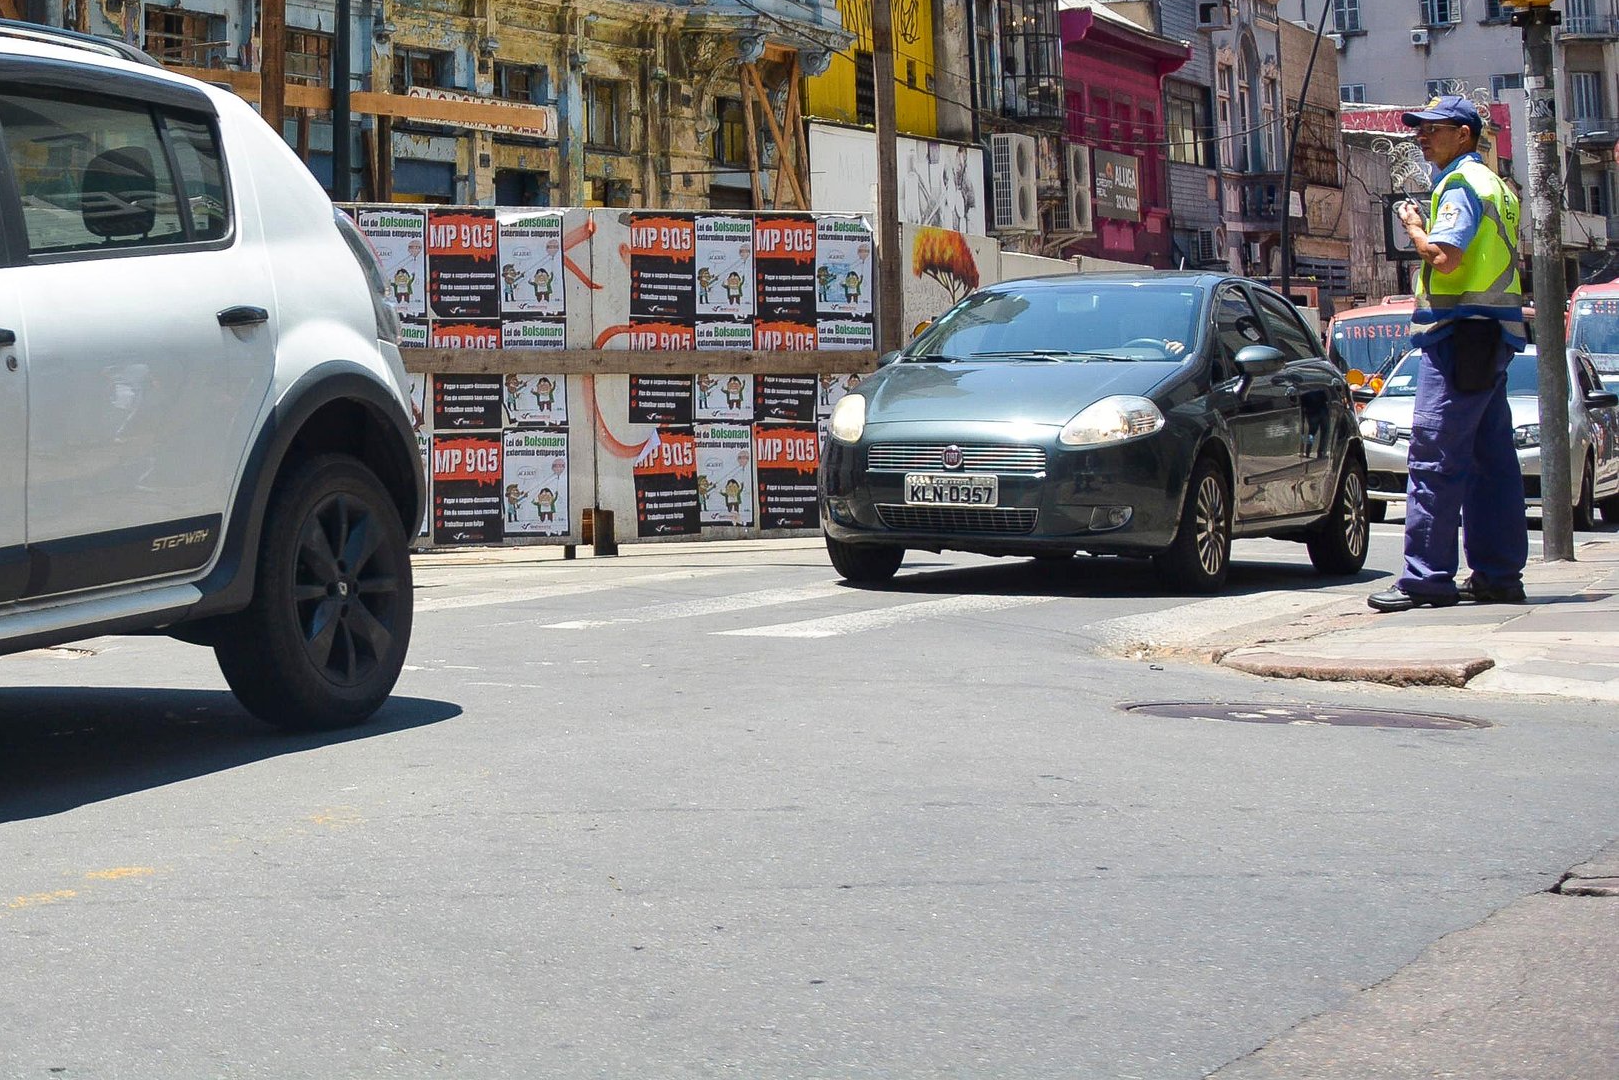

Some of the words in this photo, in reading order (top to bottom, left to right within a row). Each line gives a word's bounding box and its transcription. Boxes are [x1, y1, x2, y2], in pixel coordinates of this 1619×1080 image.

[1114, 165, 1137, 189] ALUGA
[379, 216, 422, 228] Bolsonaro
[713, 221, 750, 232] Bolsonaro
[363, 229, 391, 237] xtermina
[429, 224, 457, 249] MP
[461, 224, 494, 249] 905
[631, 227, 658, 249] MP
[661, 227, 691, 250] 905
[756, 228, 780, 251] MP
[784, 228, 813, 252] 905
[522, 325, 563, 337] Bolsonaro
[713, 326, 750, 337] Bolsonaro
[835, 325, 871, 335] Bolsonaro
[1345, 324, 1410, 340] TRISTEZA
[629, 332, 657, 350] MP
[757, 330, 782, 350] MP
[524, 435, 565, 447] Bolsonaro
[710, 427, 749, 439] Bolsonaro
[662, 442, 694, 466] 905
[757, 438, 783, 461] MP
[785, 438, 815, 462] 905
[434, 449, 462, 473] MP
[465, 448, 499, 473] 905
[910, 485, 993, 503] KLN-0357
[151, 528, 210, 552] STEPWAY
